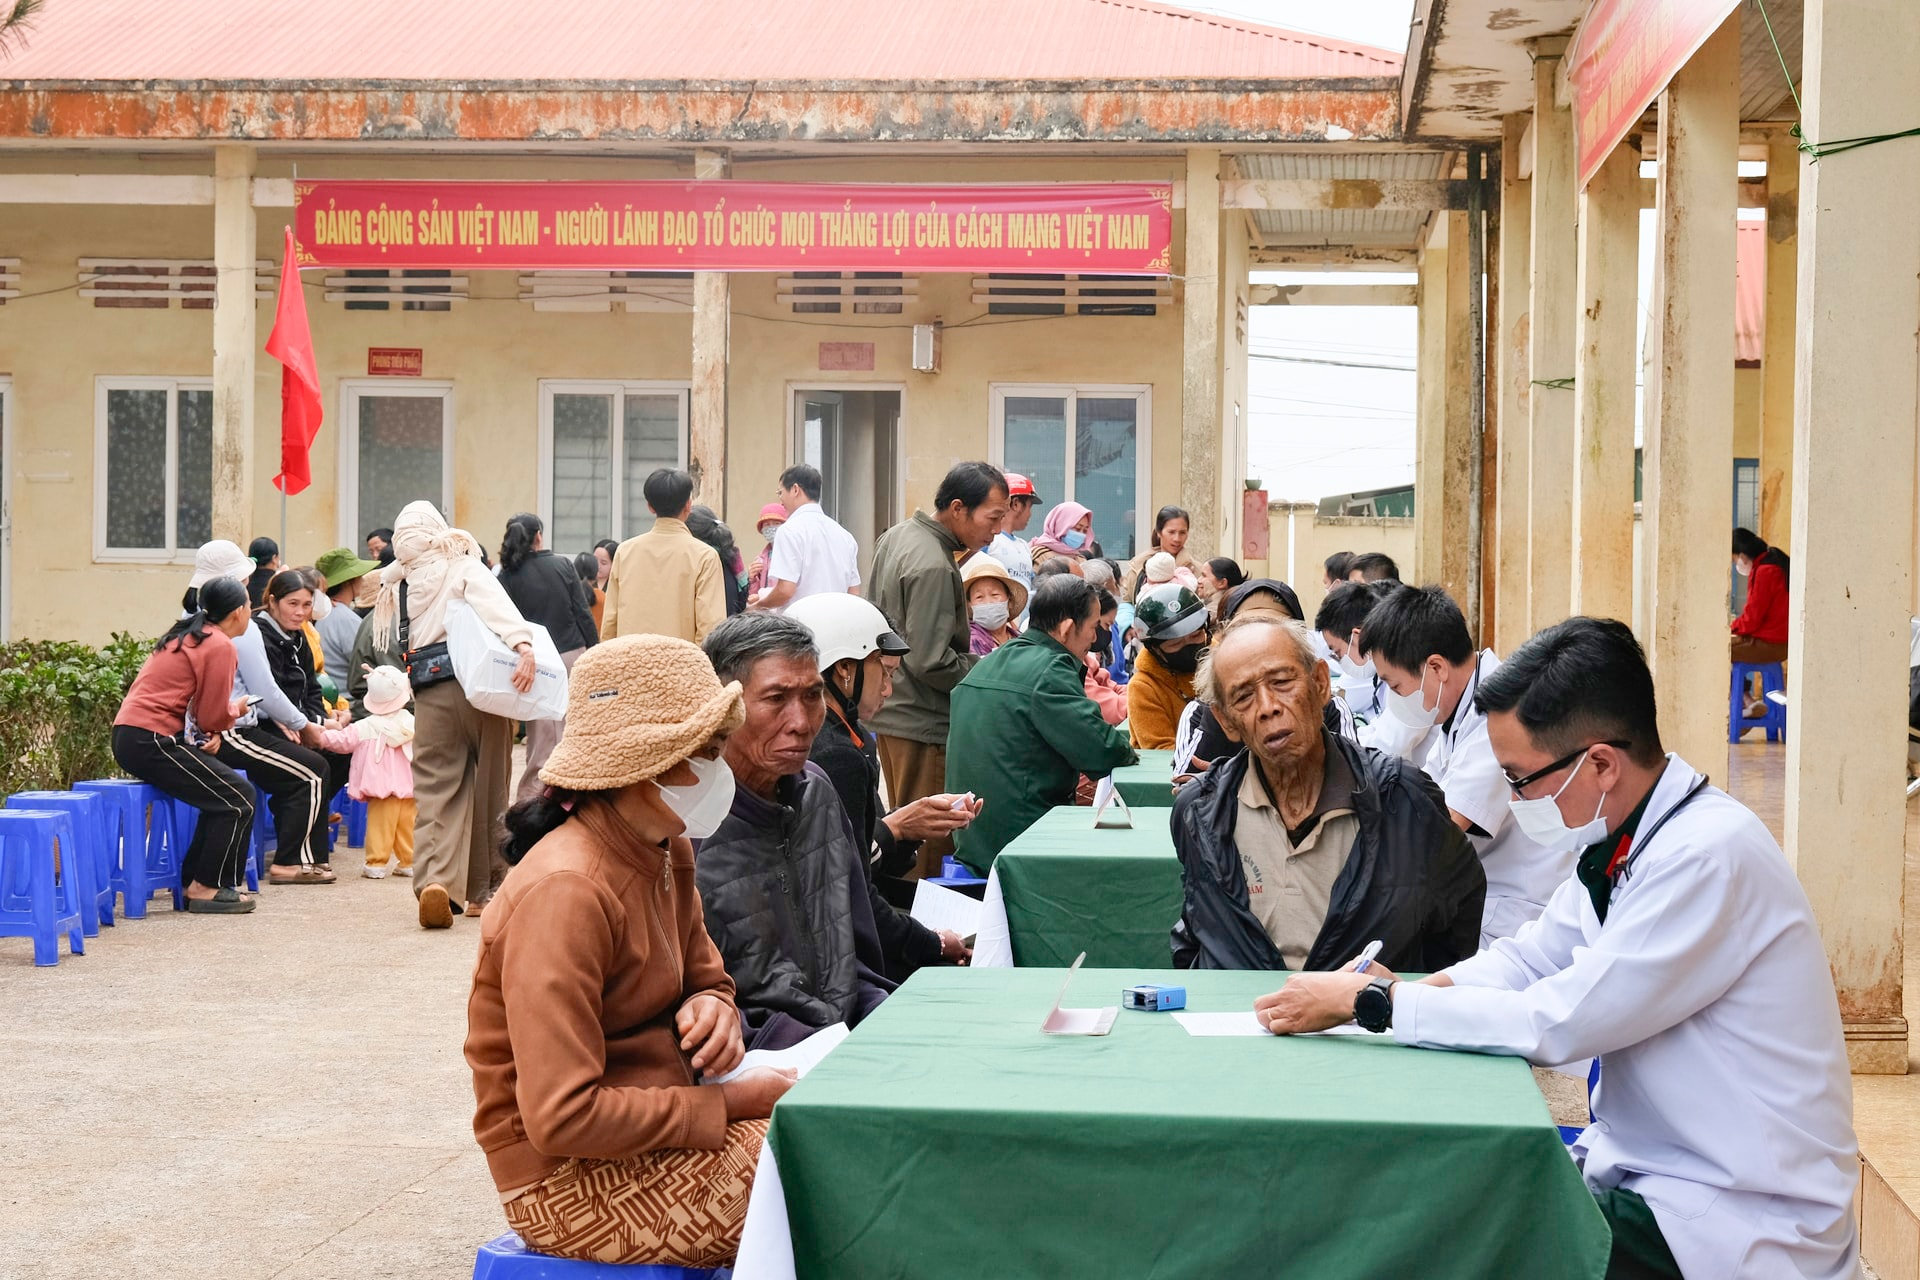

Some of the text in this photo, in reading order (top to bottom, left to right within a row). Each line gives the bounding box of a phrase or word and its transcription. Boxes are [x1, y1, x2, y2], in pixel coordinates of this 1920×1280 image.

[315, 198, 362, 245] ĐẢNG
[367, 202, 413, 253] CỘNG
[418, 198, 453, 245] SẢN
[458, 203, 494, 253] VIỆT
[499, 210, 539, 245] NAM
[555, 202, 608, 246] NGƯỜI
[613, 203, 658, 246] LÃNH
[663, 210, 698, 254] ĐẠO
[703, 197, 726, 246] TỔ
[729, 203, 776, 246] CHỨC
[781, 211, 815, 255] MỌI
[820, 198, 878, 247] THẮNG
[882, 209, 910, 255] LỢI
[915, 200, 950, 248] CỦA
[955, 205, 1003, 248] CÁCH
[1007, 213, 1061, 257] MẠNG
[1066, 206, 1103, 257] VIỆT
[1108, 214, 1149, 249] NAM
